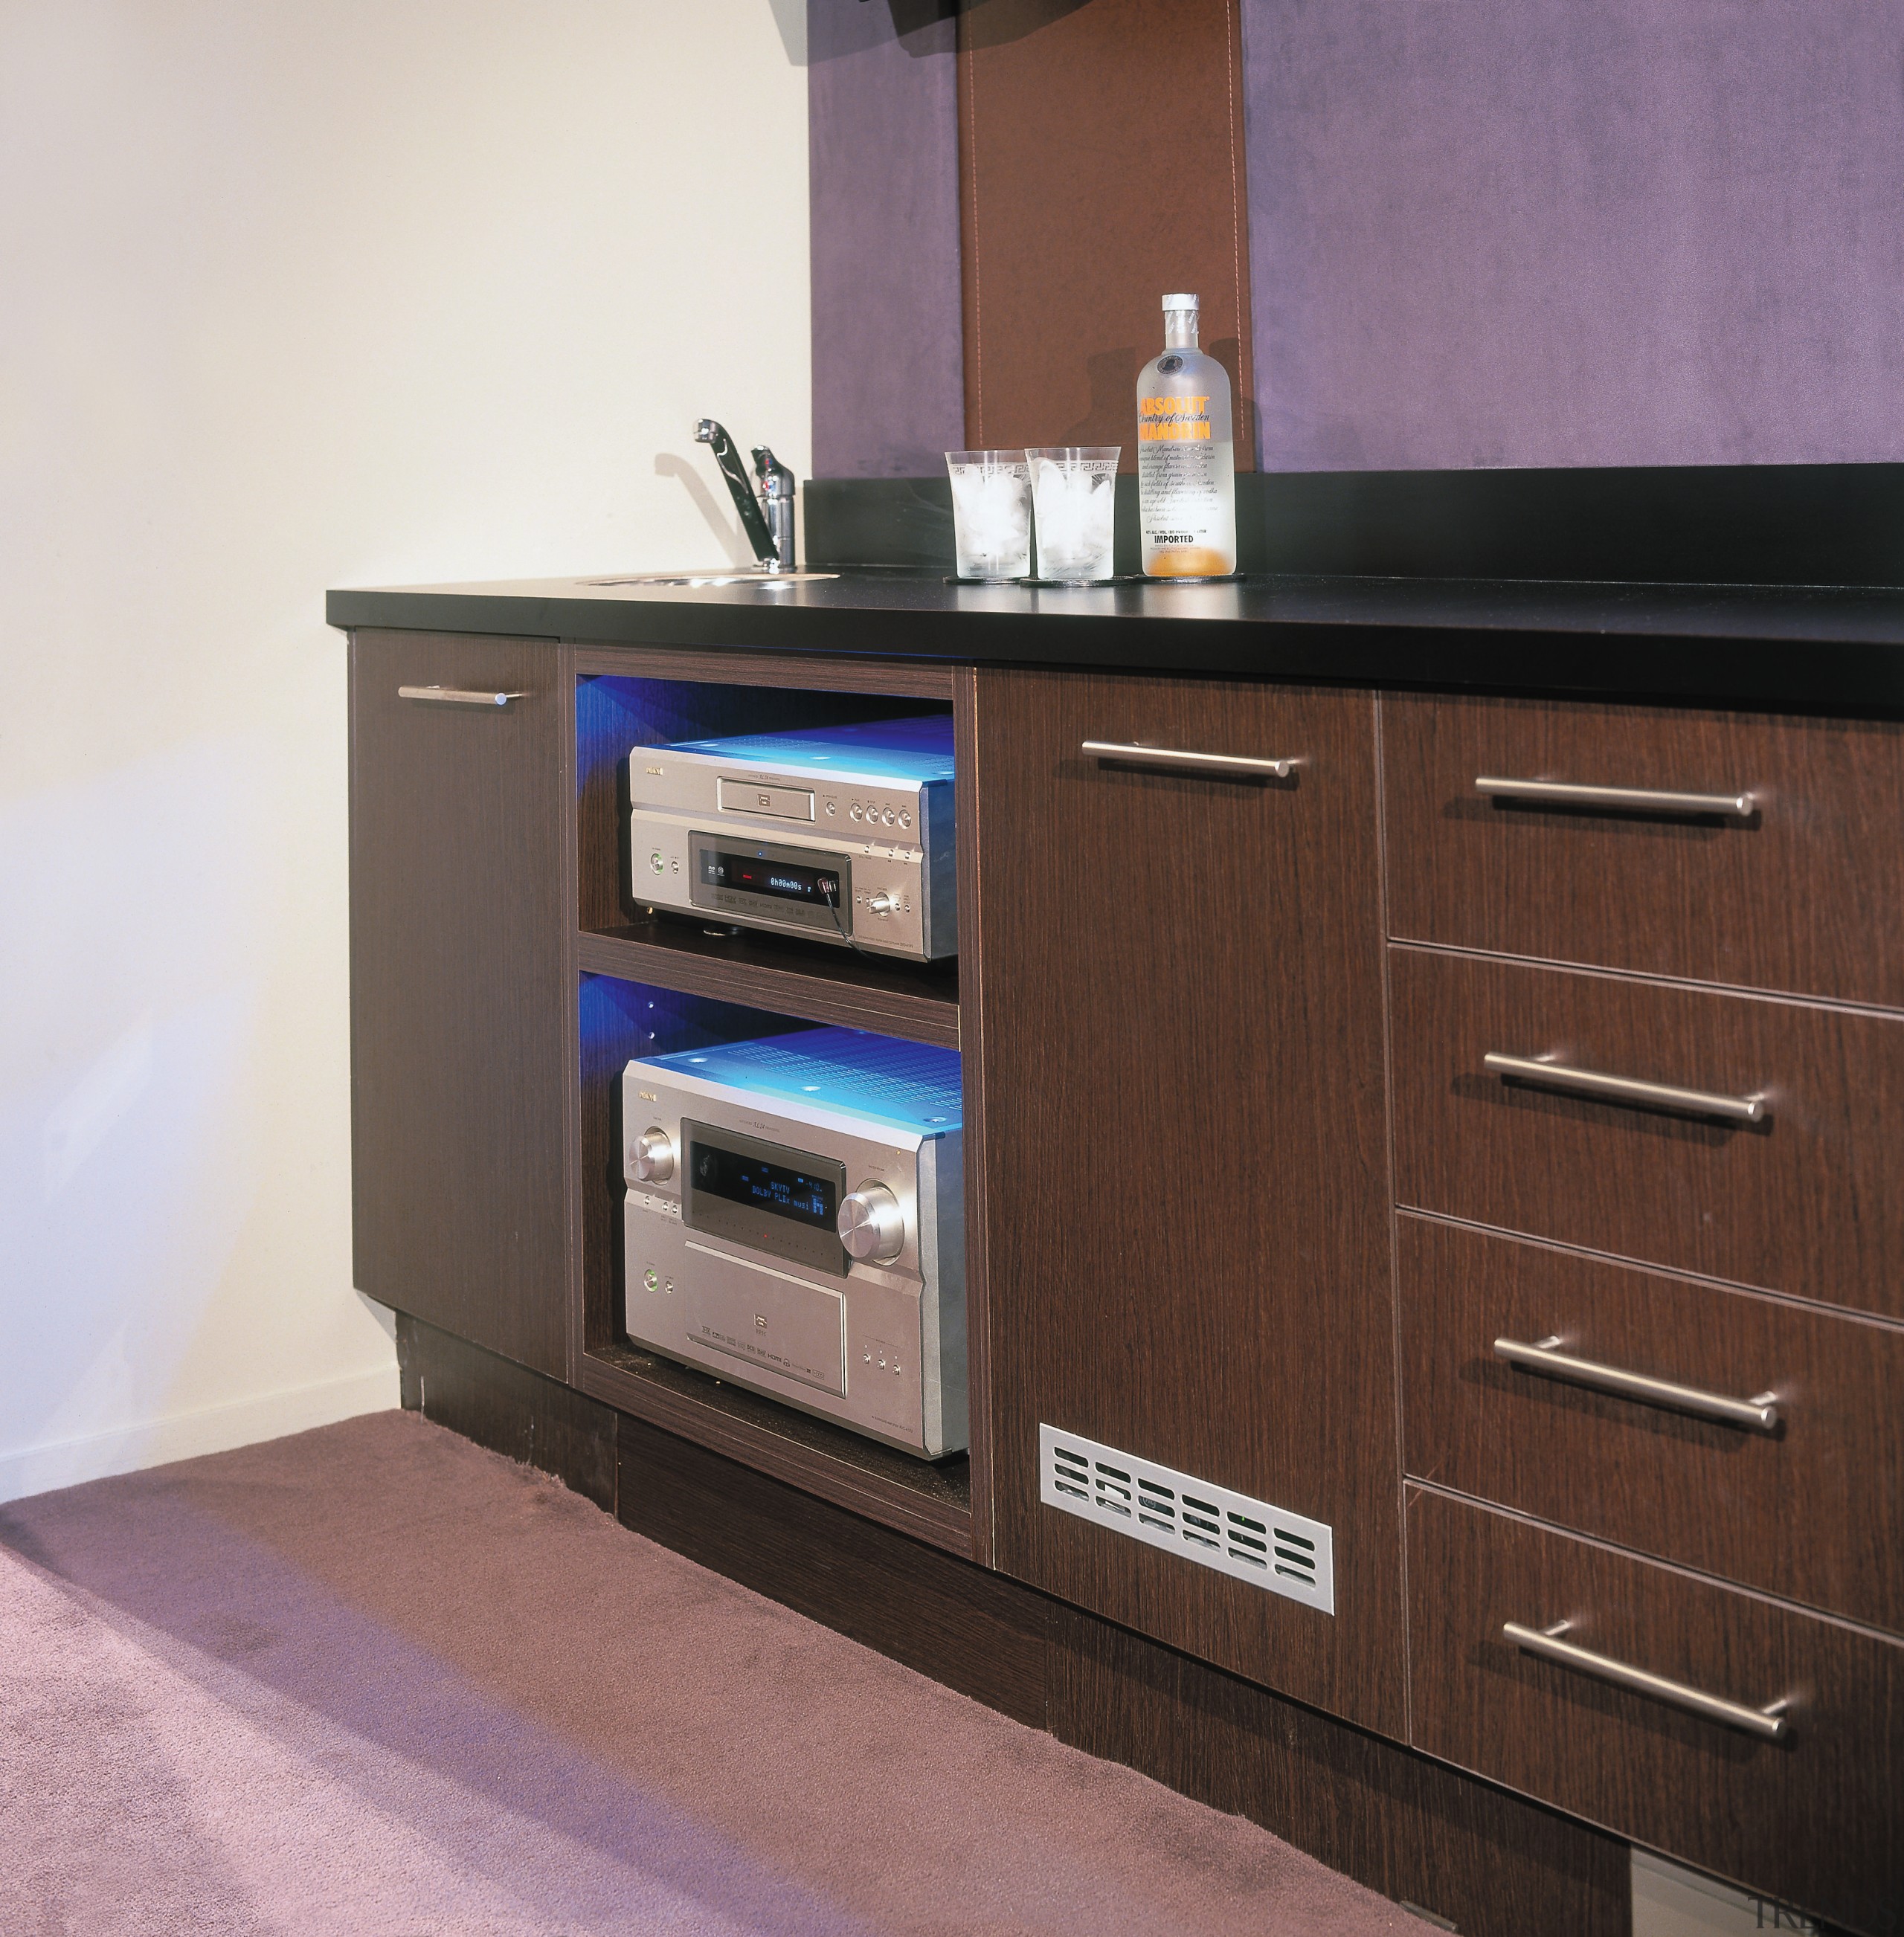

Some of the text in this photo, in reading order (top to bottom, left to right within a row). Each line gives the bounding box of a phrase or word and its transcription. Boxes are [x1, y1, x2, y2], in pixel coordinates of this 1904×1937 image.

[1141, 396, 1206, 415] ABSOLUT
[1139, 422, 1211, 440] MANDRIN
[1154, 535, 1194, 544] IMPORTED
[752, 1185, 771, 1198] DOLBY
[771, 1181, 790, 1194] SKYTV
